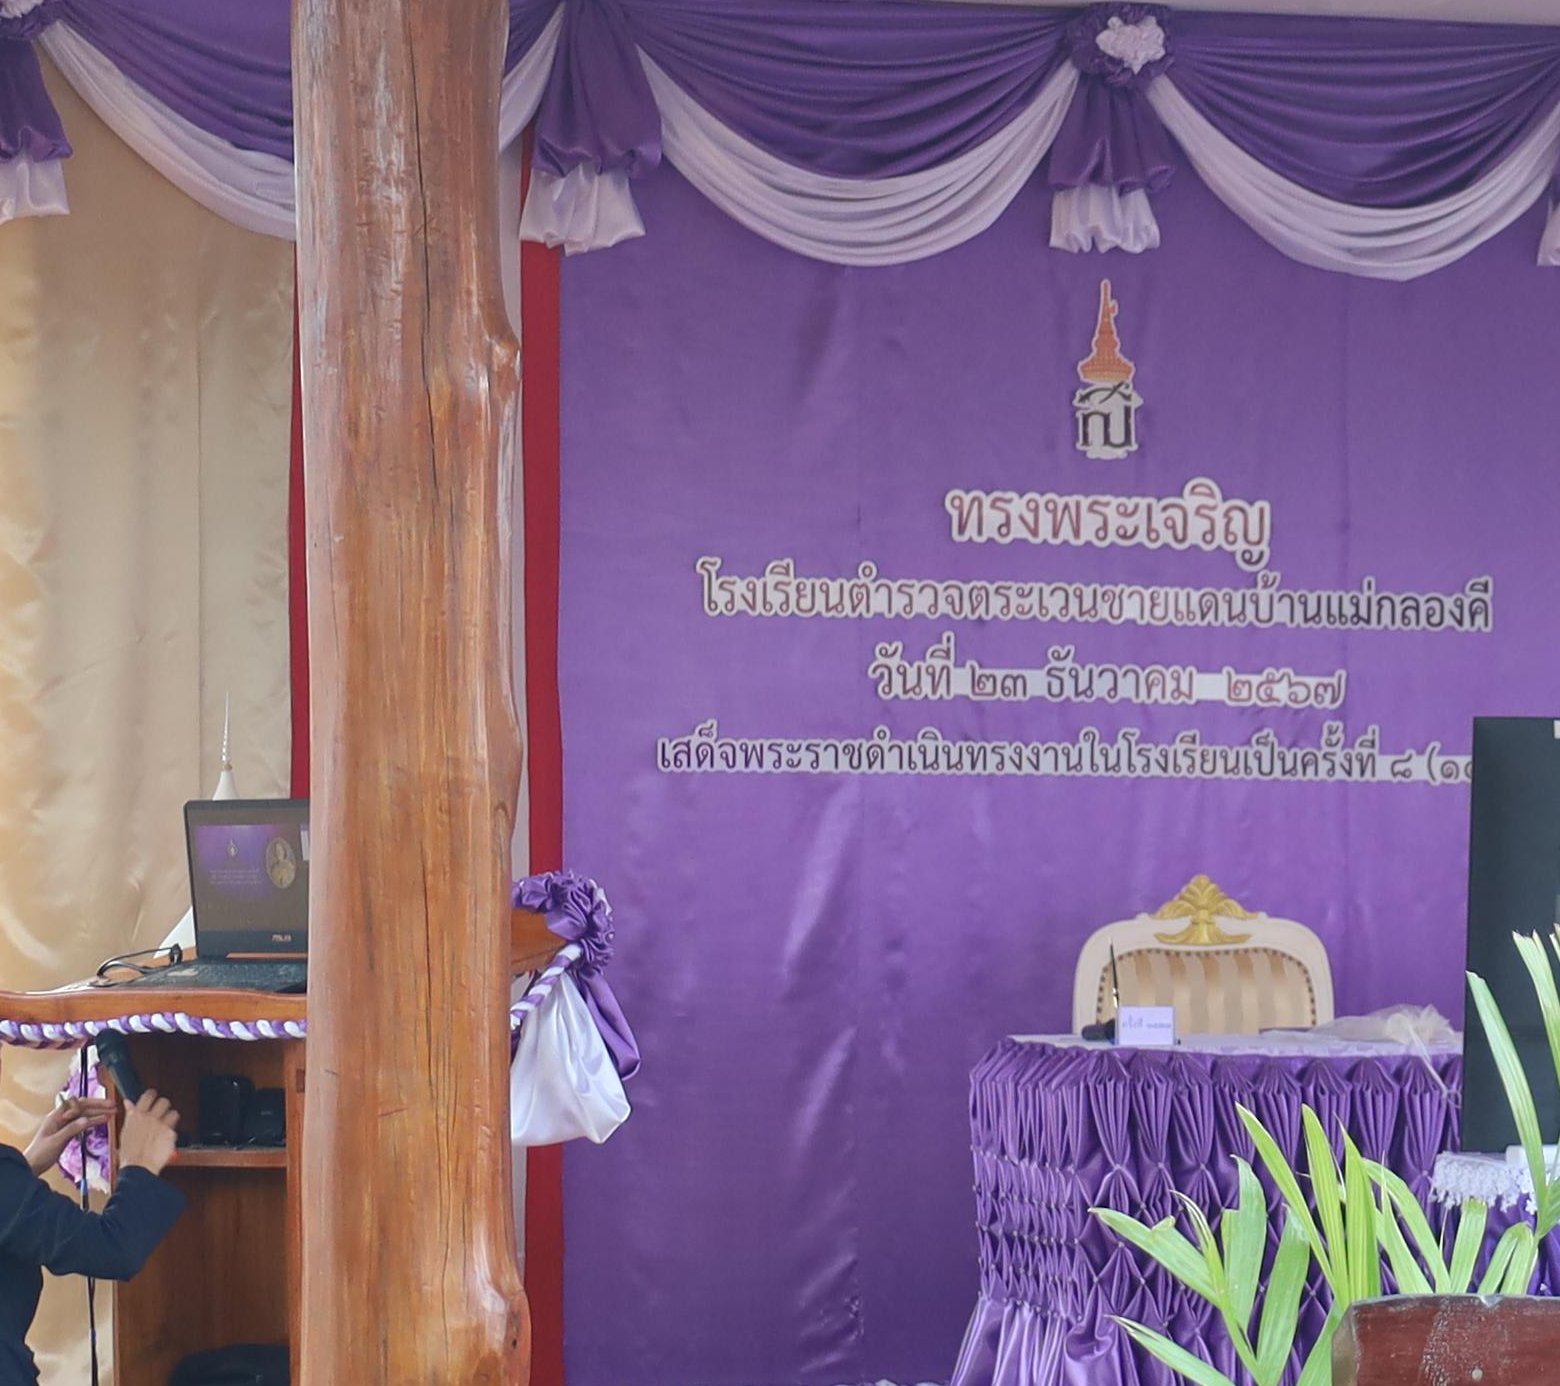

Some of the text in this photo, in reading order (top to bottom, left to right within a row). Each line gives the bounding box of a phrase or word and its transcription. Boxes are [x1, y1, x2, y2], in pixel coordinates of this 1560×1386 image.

[949, 481, 1267, 567] ทรงพระเจริญ
[698, 557, 1491, 630] โรงเรียนตำรวจตระเวนชายแดนบ้านแม่กลองคี
[871, 634, 1345, 707] วันที่ ๒๓ ธันวาคม ๒๕๖๗
